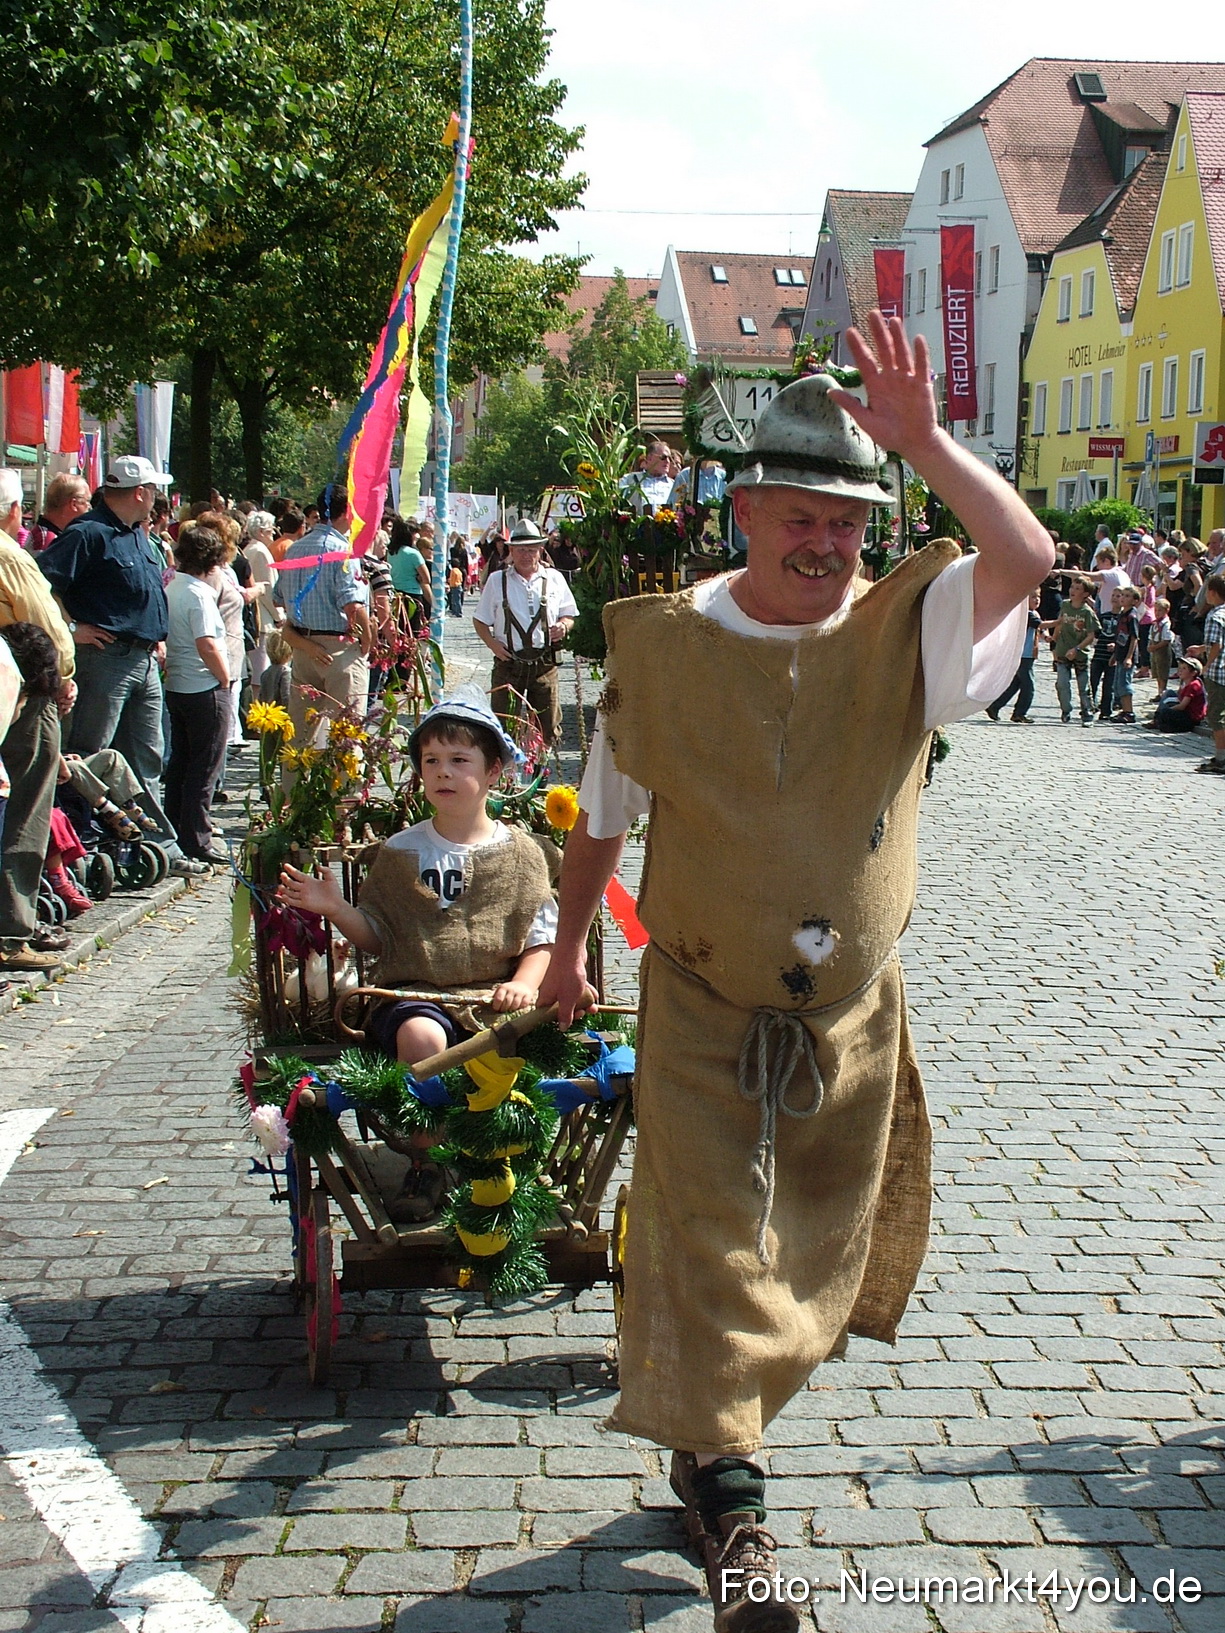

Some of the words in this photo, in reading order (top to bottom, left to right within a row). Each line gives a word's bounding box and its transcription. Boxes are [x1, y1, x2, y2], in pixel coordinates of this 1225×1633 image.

[947, 284, 969, 396] REDUZIERT
[1068, 345, 1092, 369] HOTEL
[1098, 341, 1126, 361] Lehmeier
[745, 387, 783, 411] 11
[1061, 457, 1095, 472] Restaurant
